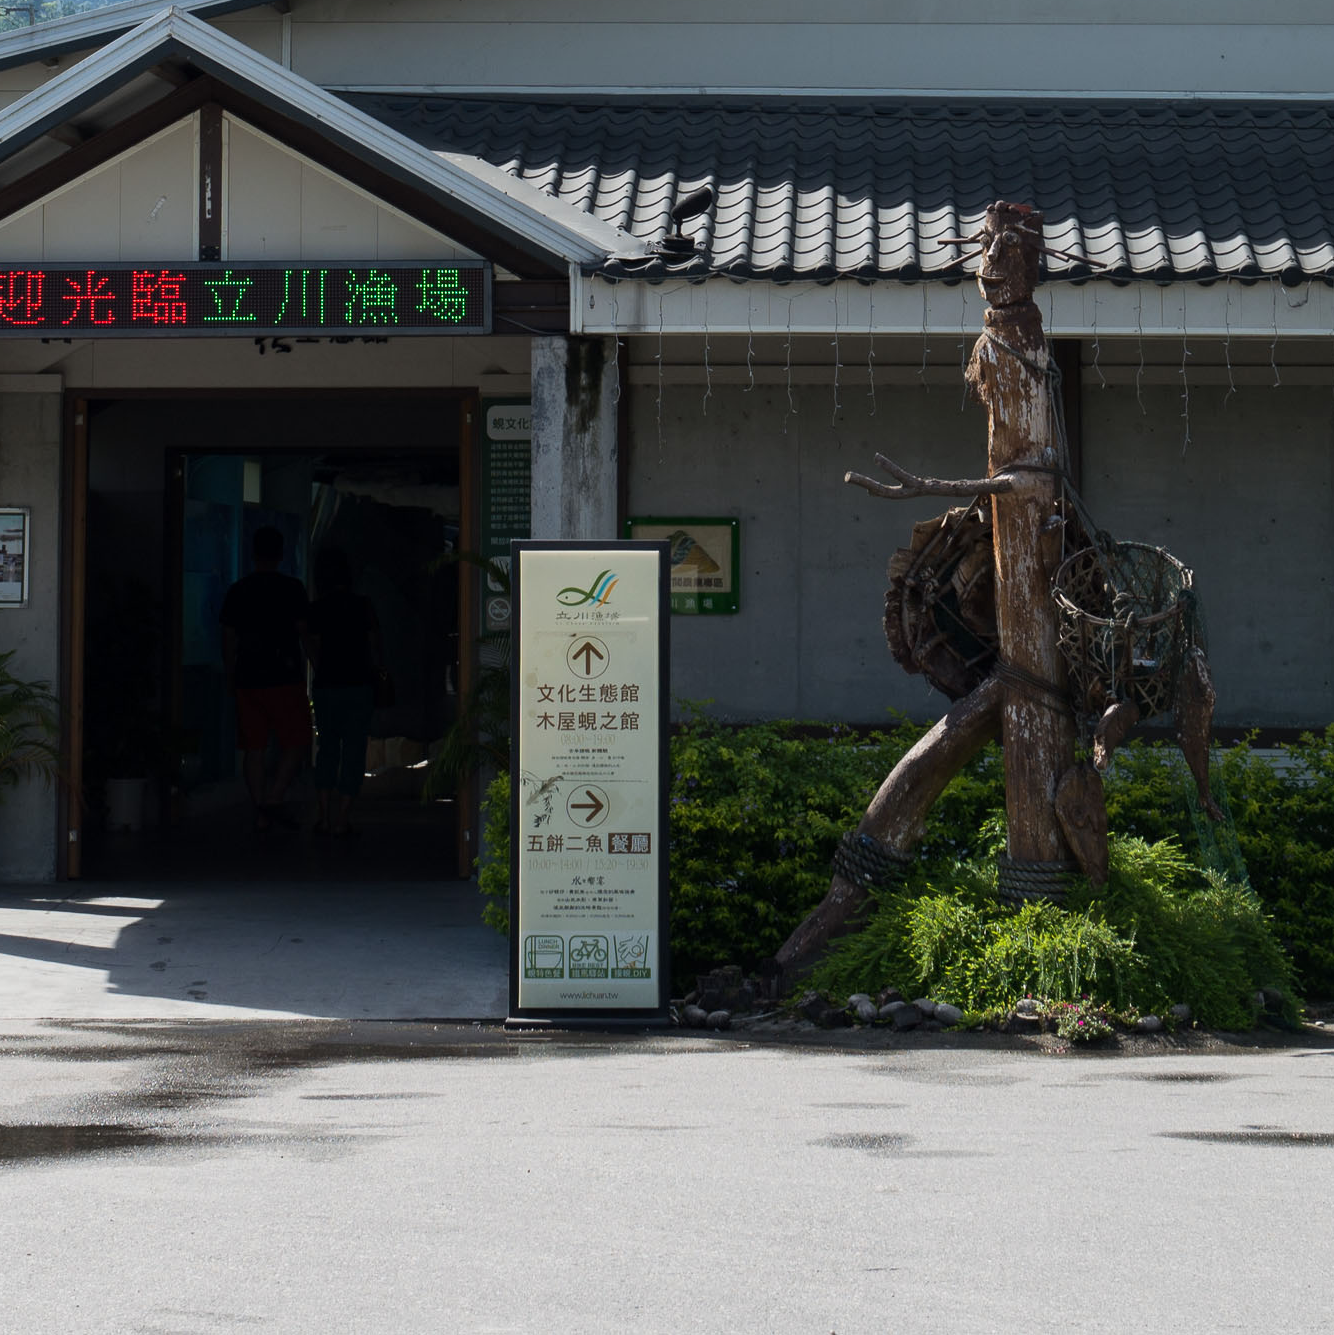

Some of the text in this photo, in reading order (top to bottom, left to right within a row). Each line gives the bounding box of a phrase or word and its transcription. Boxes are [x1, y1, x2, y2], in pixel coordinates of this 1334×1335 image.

[492, 417, 531, 431] 蜆文化
[537, 684, 640, 703] 文化生態館
[537, 712, 640, 731] 木屋蜆之館
[526, 833, 648, 853] 五餅二魚 餐廳
